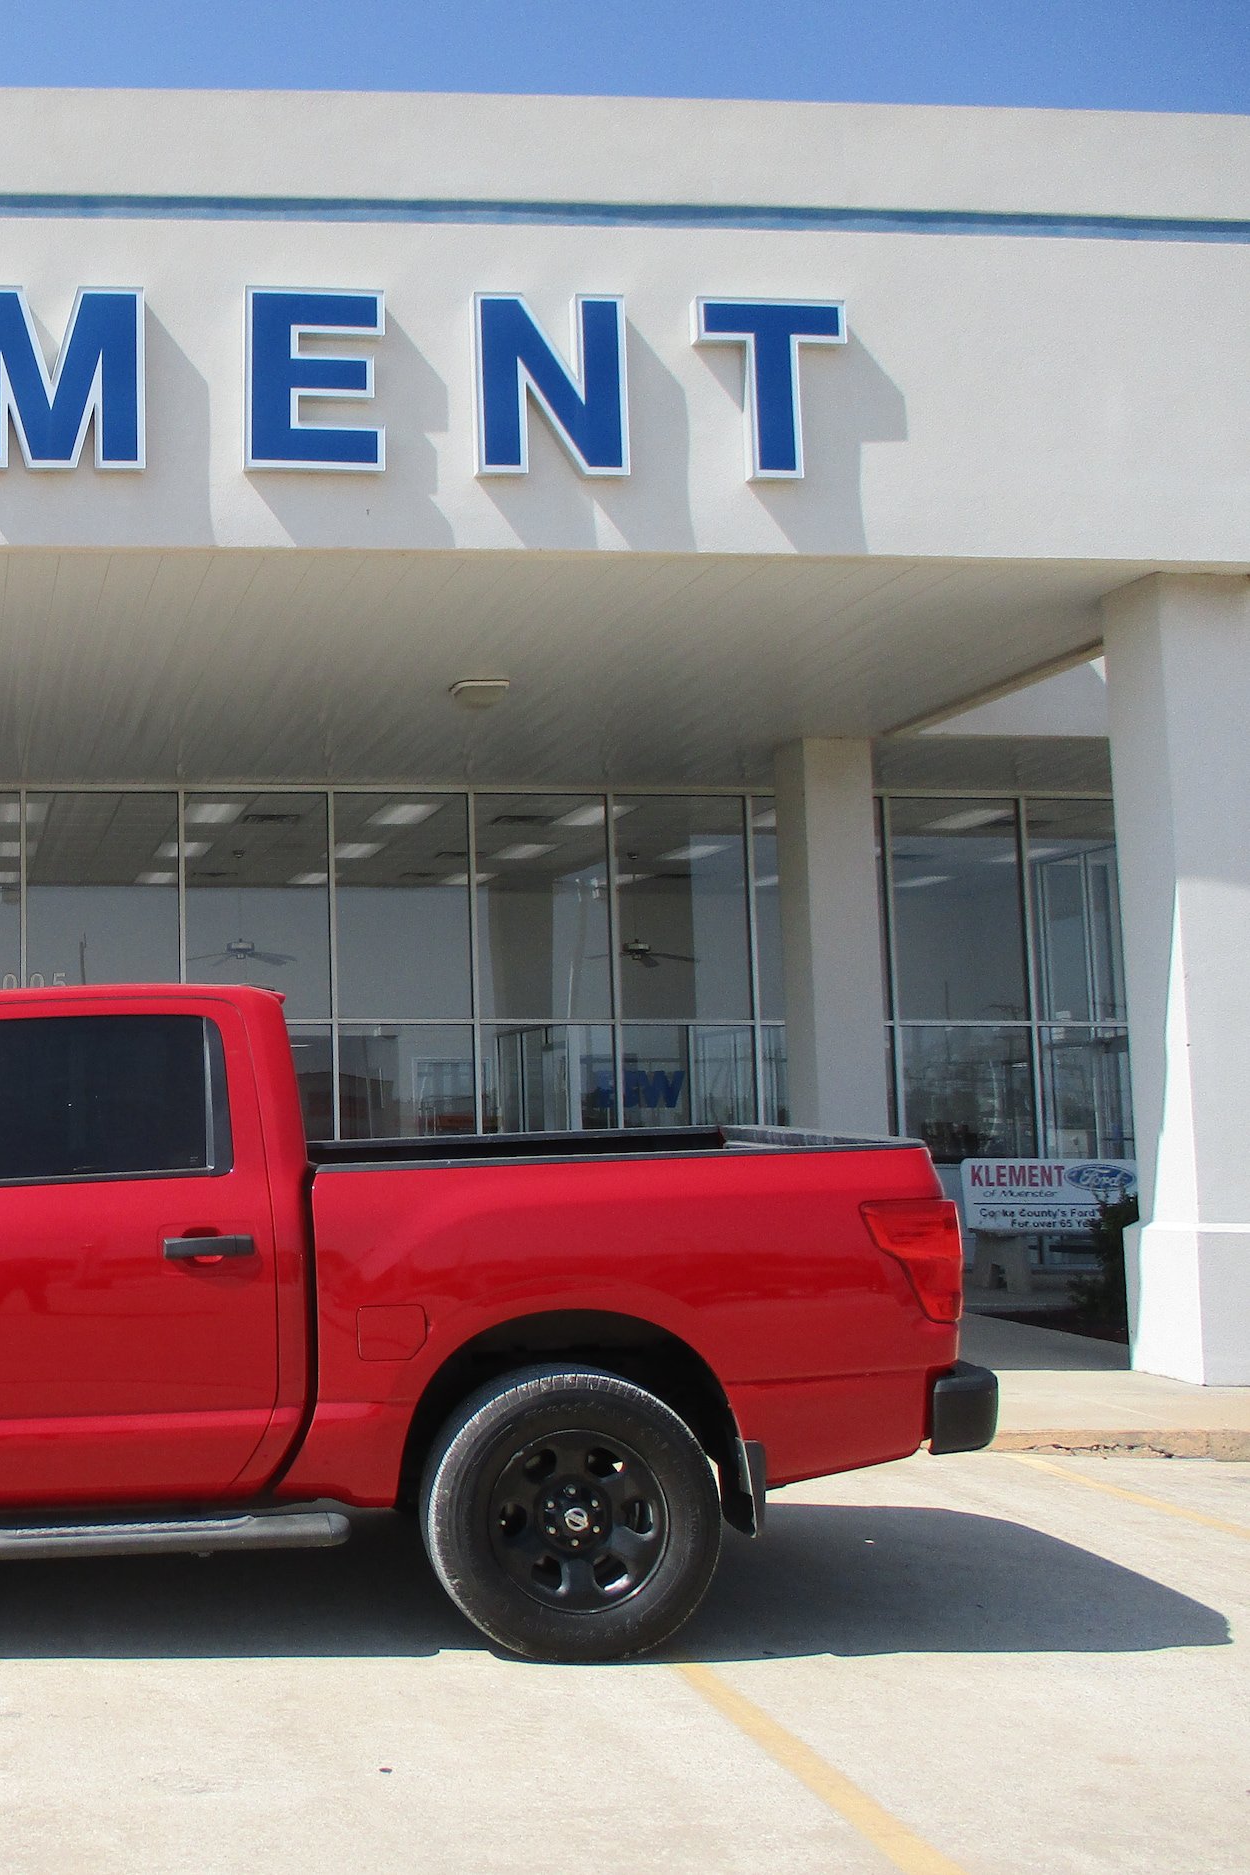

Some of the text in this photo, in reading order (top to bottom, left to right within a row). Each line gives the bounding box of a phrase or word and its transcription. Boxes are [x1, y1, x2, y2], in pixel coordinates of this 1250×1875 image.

[970, 1164, 1066, 1188] KLEMENT
[983, 1189, 997, 1199] of
[979, 1208, 1096, 1219] Coke County's Ford
